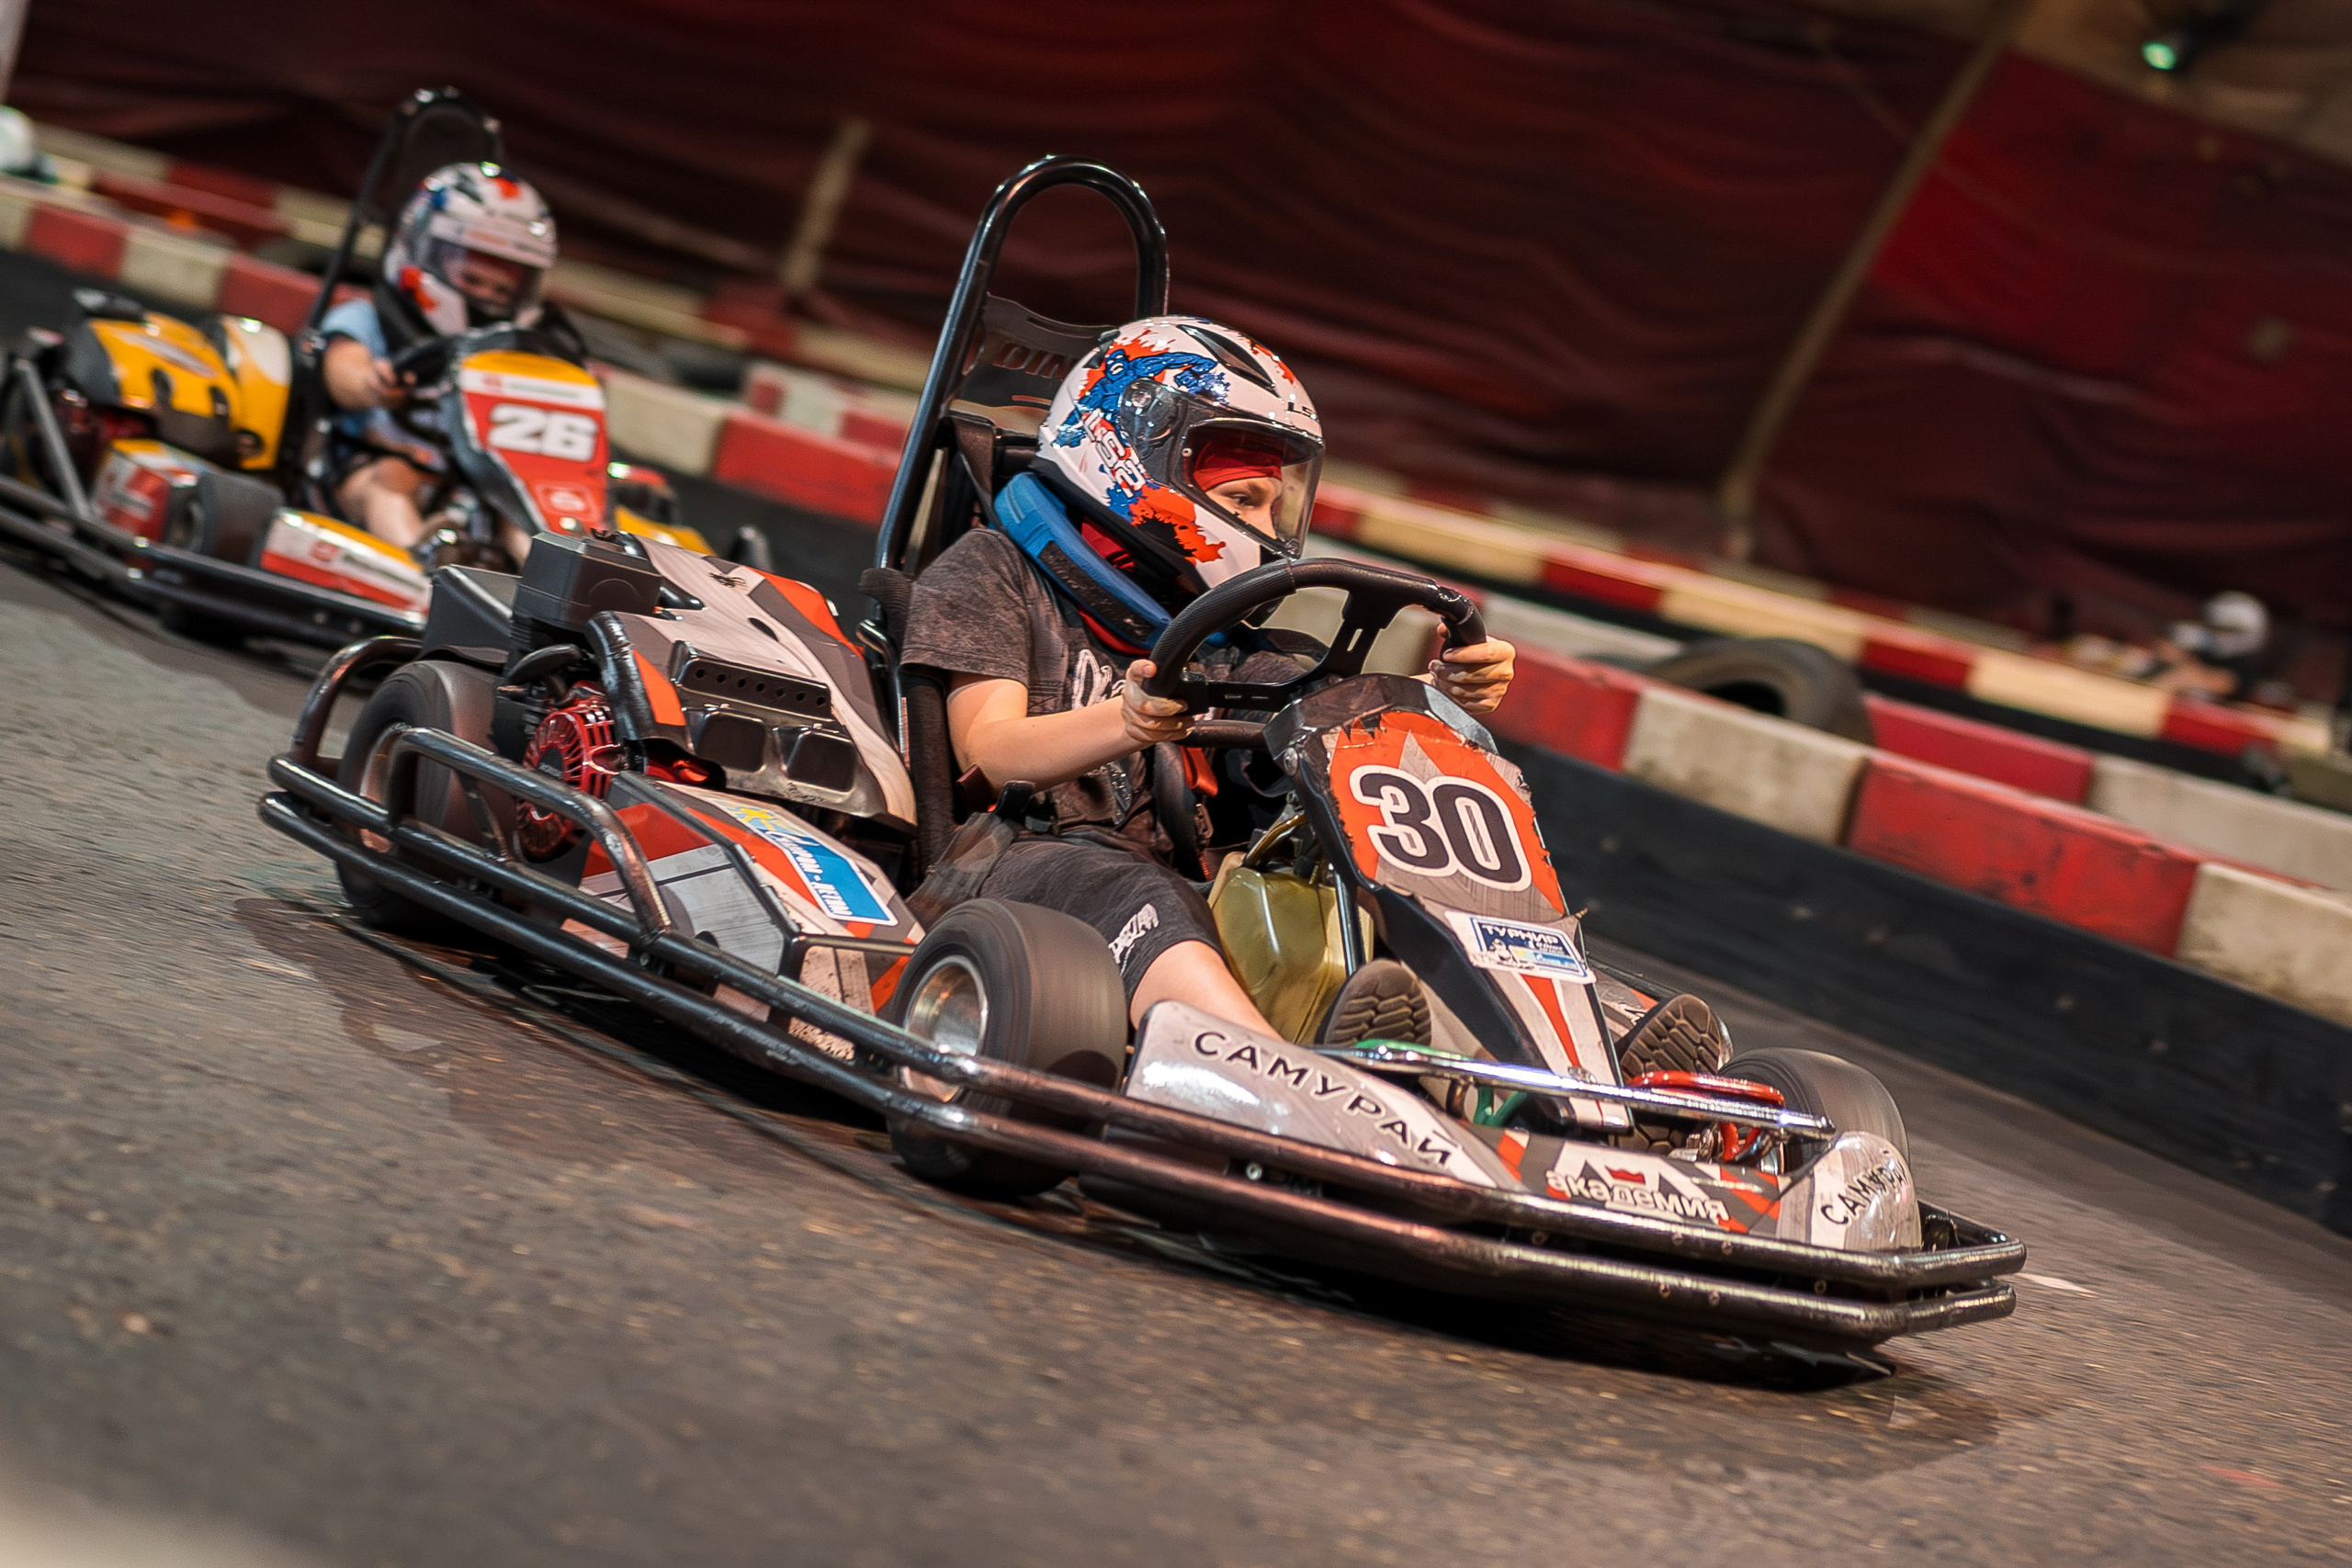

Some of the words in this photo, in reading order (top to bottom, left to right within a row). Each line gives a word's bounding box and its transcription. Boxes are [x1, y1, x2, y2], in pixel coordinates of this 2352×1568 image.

[488, 402, 599, 463] 26
[1083, 408, 1146, 498] LS2
[1350, 764, 1532, 892] 30
[1481, 924, 1558, 945] ТУРНИР
[1194, 1031, 1458, 1167] САМУРАЙ
